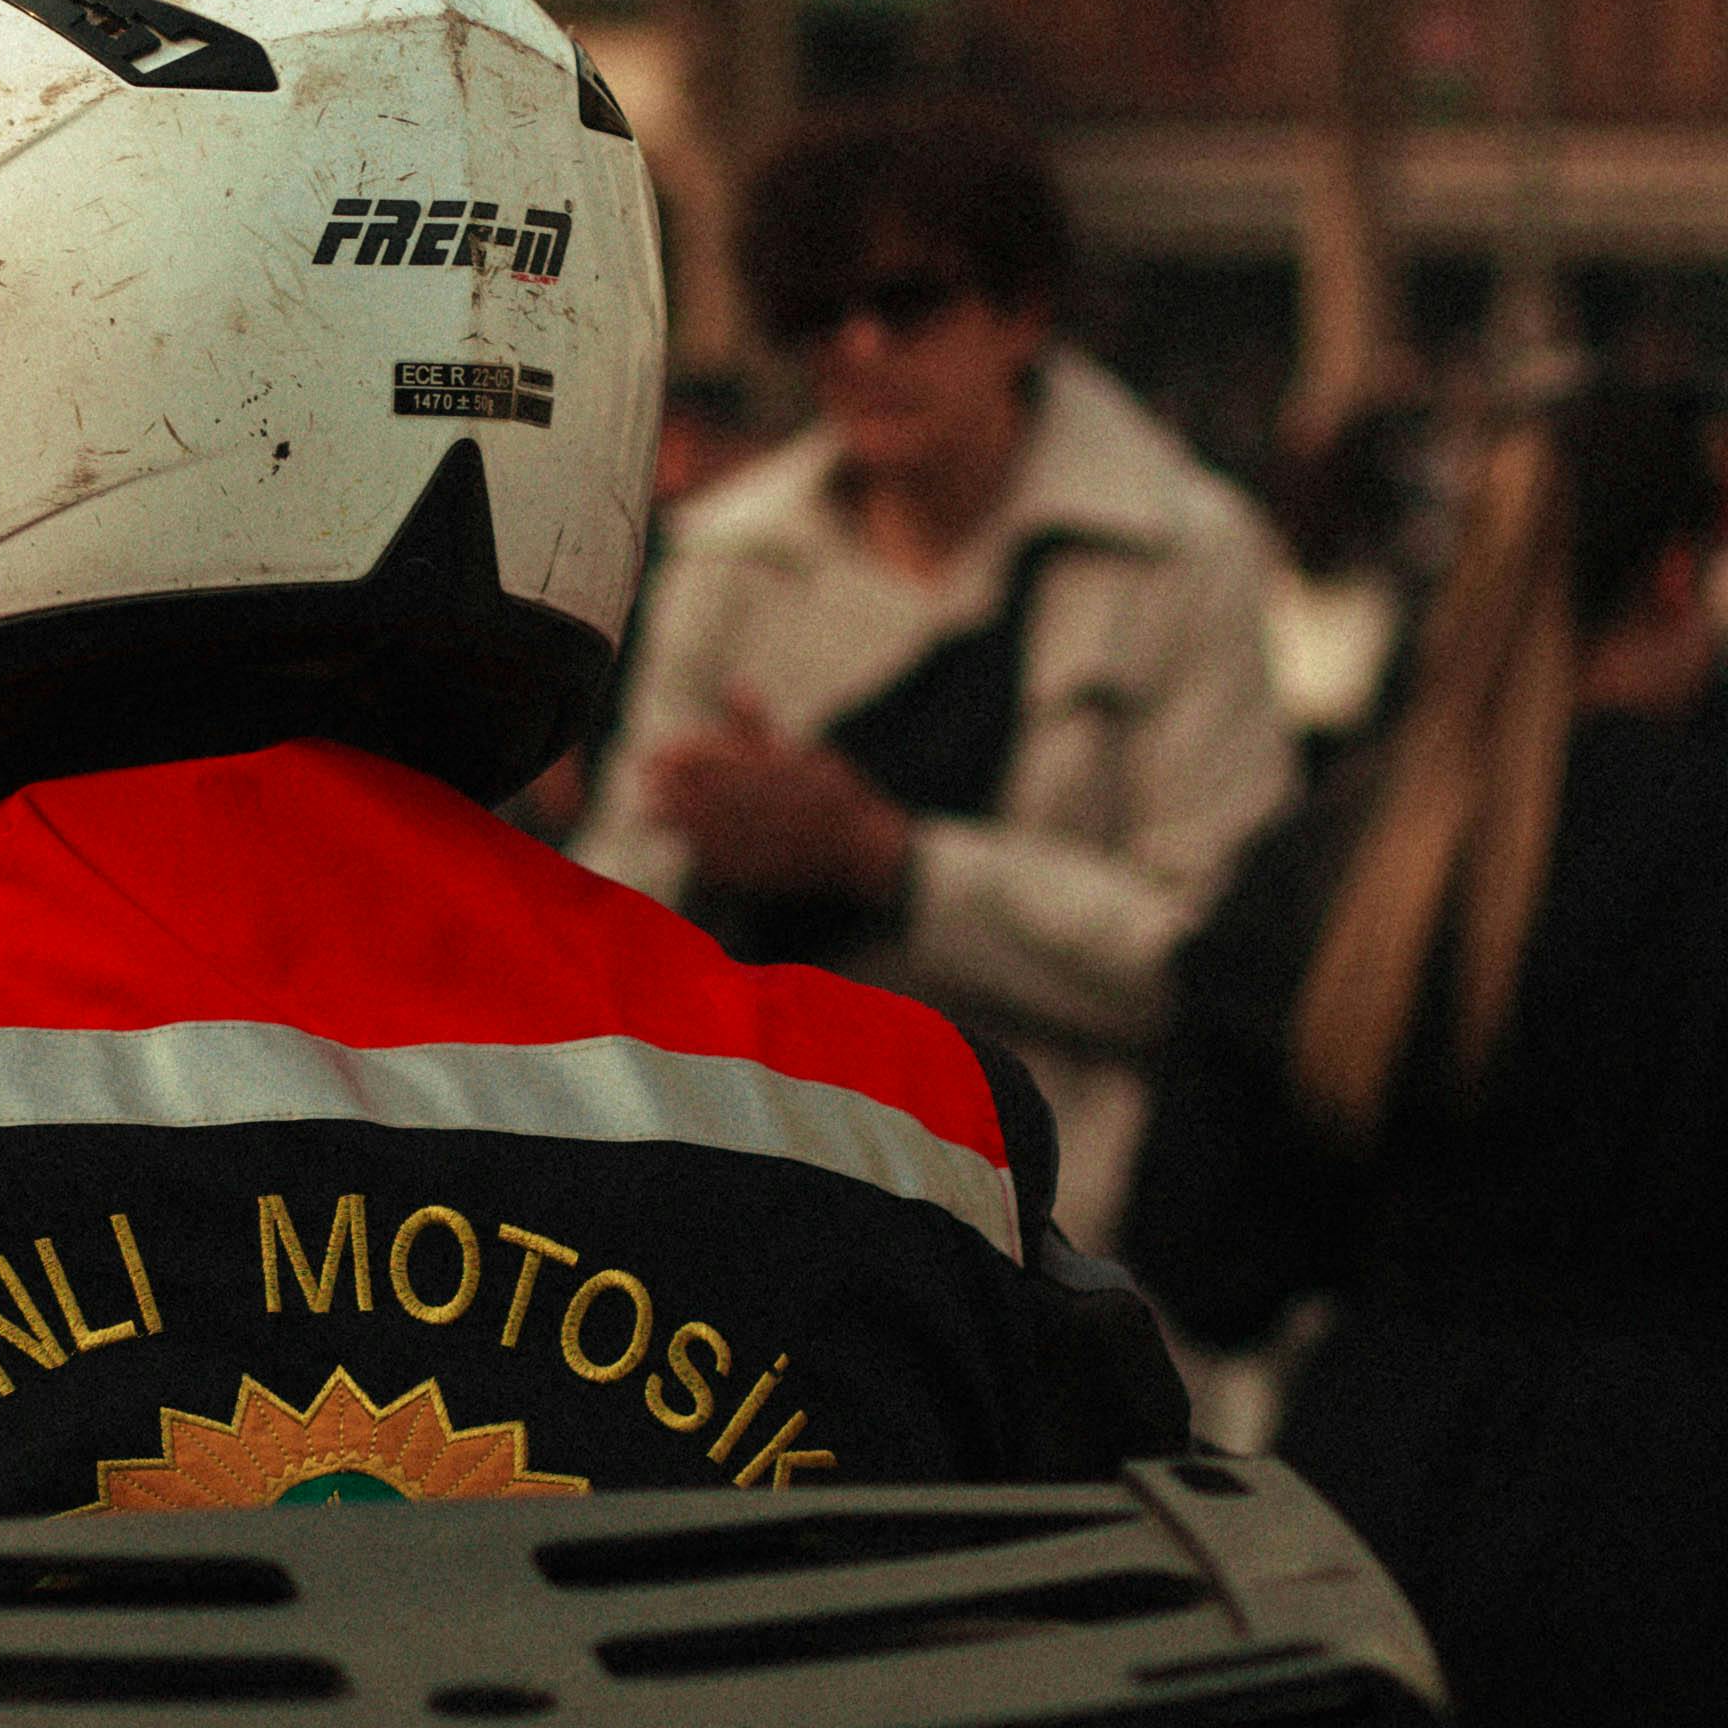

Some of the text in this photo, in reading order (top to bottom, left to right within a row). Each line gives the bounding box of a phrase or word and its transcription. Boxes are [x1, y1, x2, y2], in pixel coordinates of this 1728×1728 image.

[401, 364, 511, 388] ECE R 22-05
[413, 392, 453, 411] 1470
[257, 1193, 839, 1492] MOTOSİK
